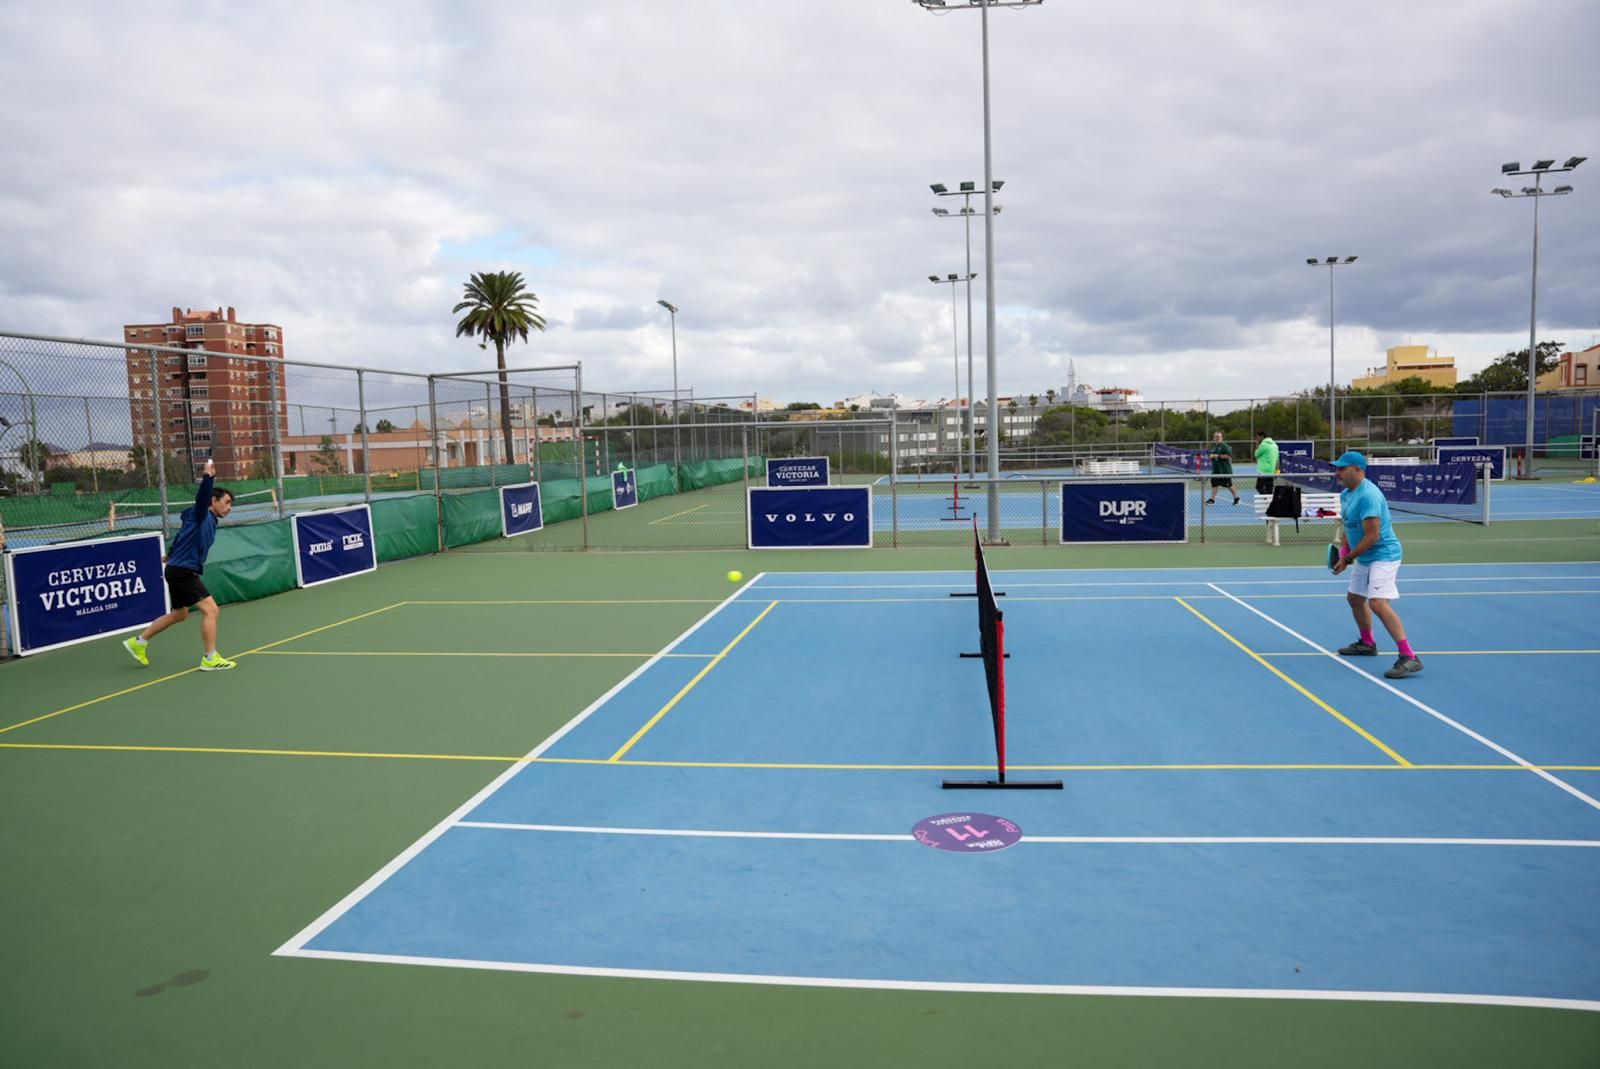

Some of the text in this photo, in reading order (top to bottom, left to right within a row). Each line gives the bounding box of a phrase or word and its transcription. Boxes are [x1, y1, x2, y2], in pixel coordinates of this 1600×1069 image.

[776, 471, 820, 479] VICTORIA
[1099, 500, 1147, 516] DUPR
[765, 513, 855, 522] VOLVO
[48, 560, 137, 587] CERVEZAS
[40, 576, 147, 611] VICTORIA
